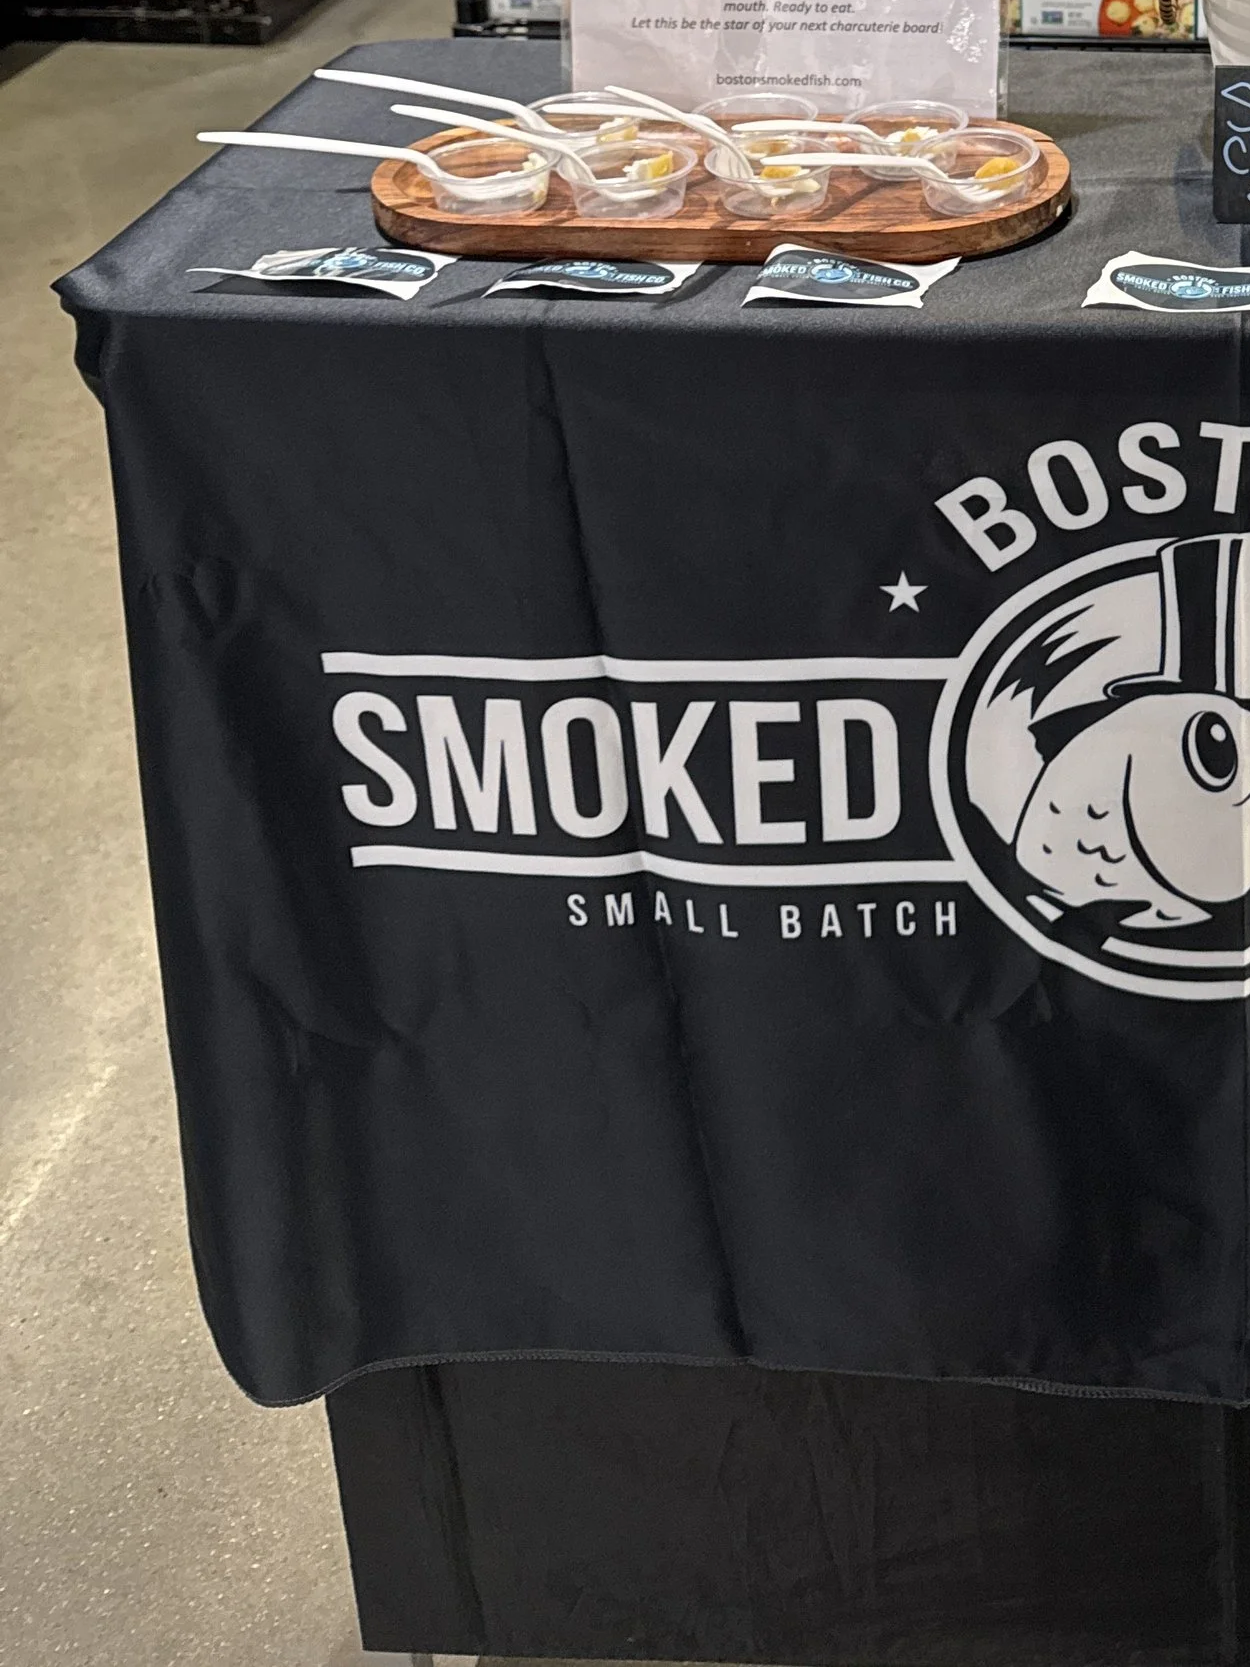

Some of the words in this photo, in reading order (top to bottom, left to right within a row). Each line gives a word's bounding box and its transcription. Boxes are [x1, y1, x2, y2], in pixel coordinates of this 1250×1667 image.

[723, 1, 769, 13] mouth.
[773, 1, 813, 14] Ready
[815, 3, 828, 13] to
[831, 3, 856, 14] eat.
[631, 17, 652, 29] Let
[654, 18, 678, 30] this
[680, 18, 697, 30] be
[700, 18, 721, 30] the
[723, 20, 749, 31] star
[768, 21, 796, 33] your
[800, 21, 827, 32] next
[829, 21, 901, 33] charcuterie
[716, 73, 862, 87] bostonsmokedfish.com
[616, 272, 645, 283] FISH
[863, 272, 893, 283] FISH
[1116, 272, 1168, 290] SMOKED
[1222, 285, 1250, 294] FISH
[331, 689, 904, 847] SMOKED
[567, 889, 740, 940] SMALL
[781, 900, 959, 940] BATCH
